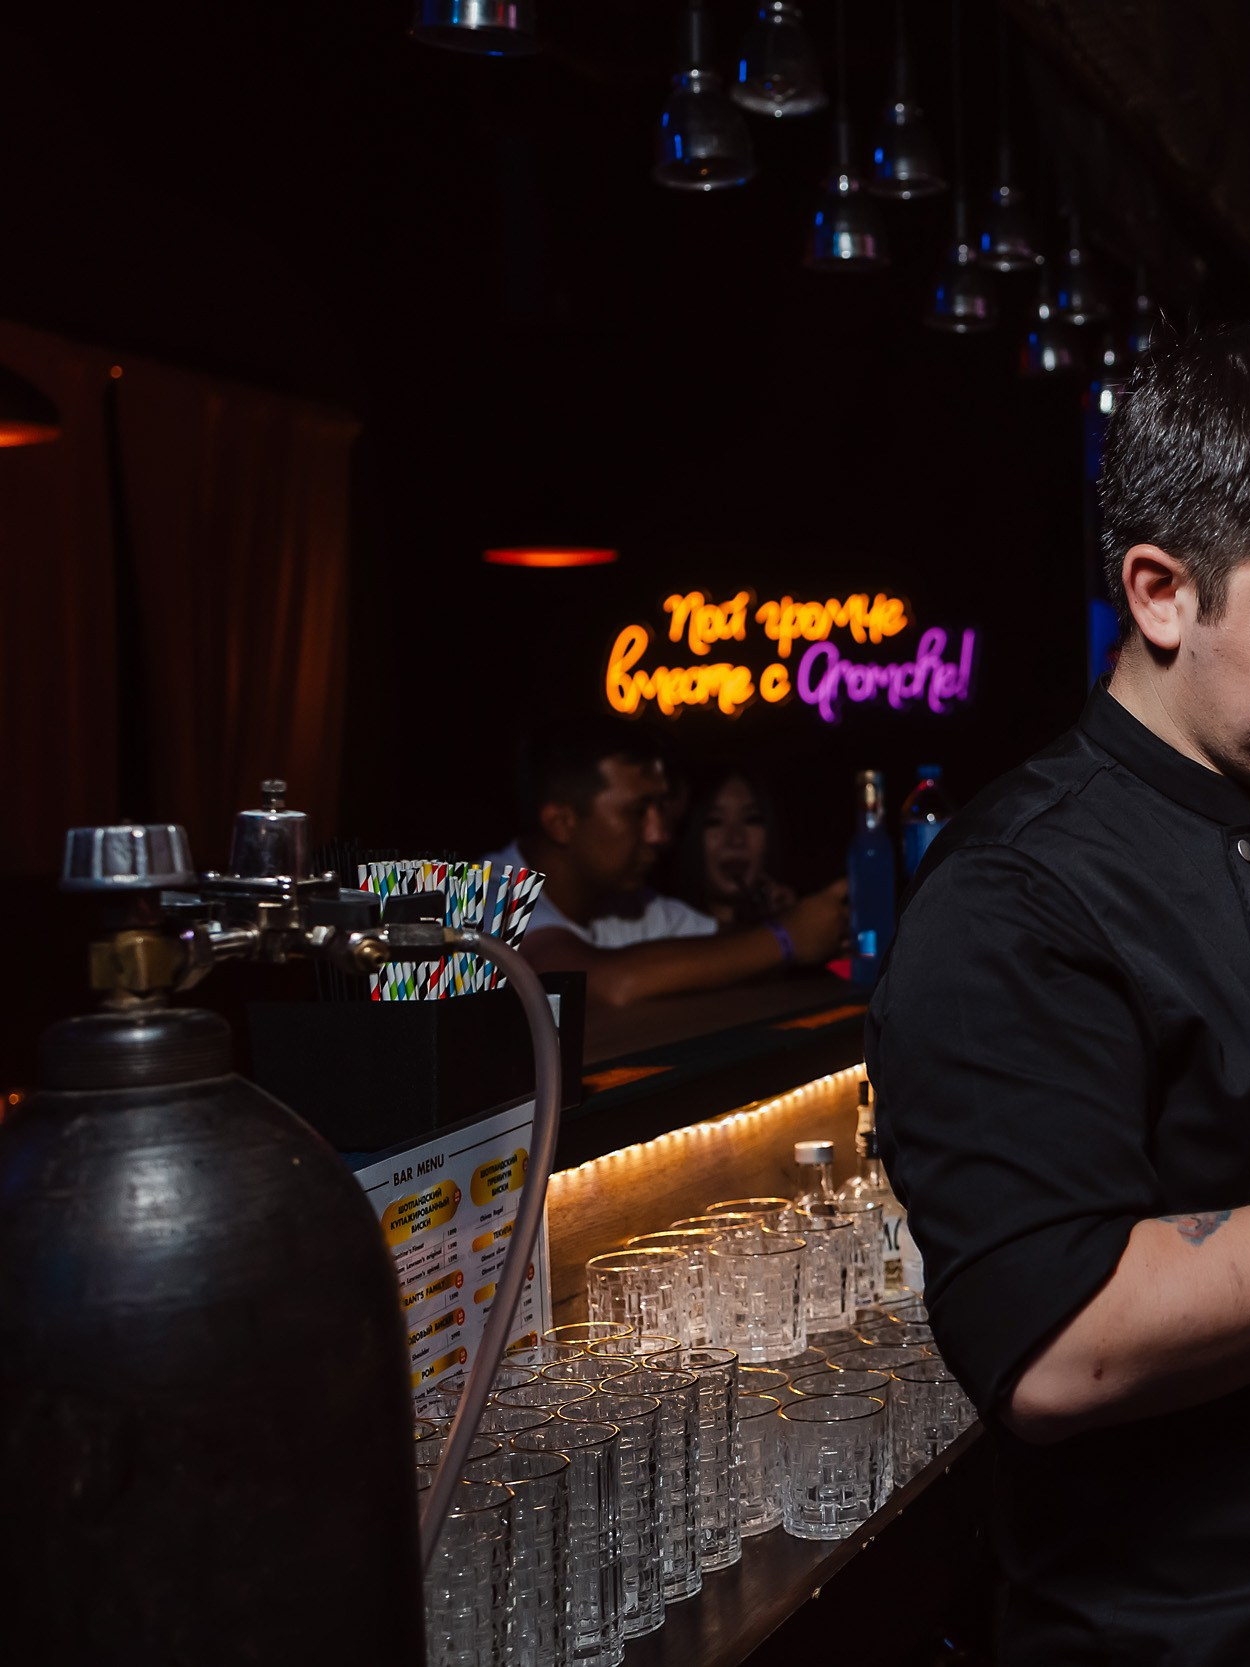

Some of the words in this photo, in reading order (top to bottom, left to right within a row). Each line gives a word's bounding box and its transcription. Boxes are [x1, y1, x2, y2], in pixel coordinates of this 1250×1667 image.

[394, 1167, 413, 1187] BAR
[417, 1154, 444, 1178] MENU
[390, 1196, 450, 1230] КУПАЖИРОВАННЫЙ
[398, 1188, 442, 1214] ШОТЛАНДСКИЙ
[411, 1218, 432, 1234] ВИСКИ
[422, 1366, 434, 1380] РОМ
